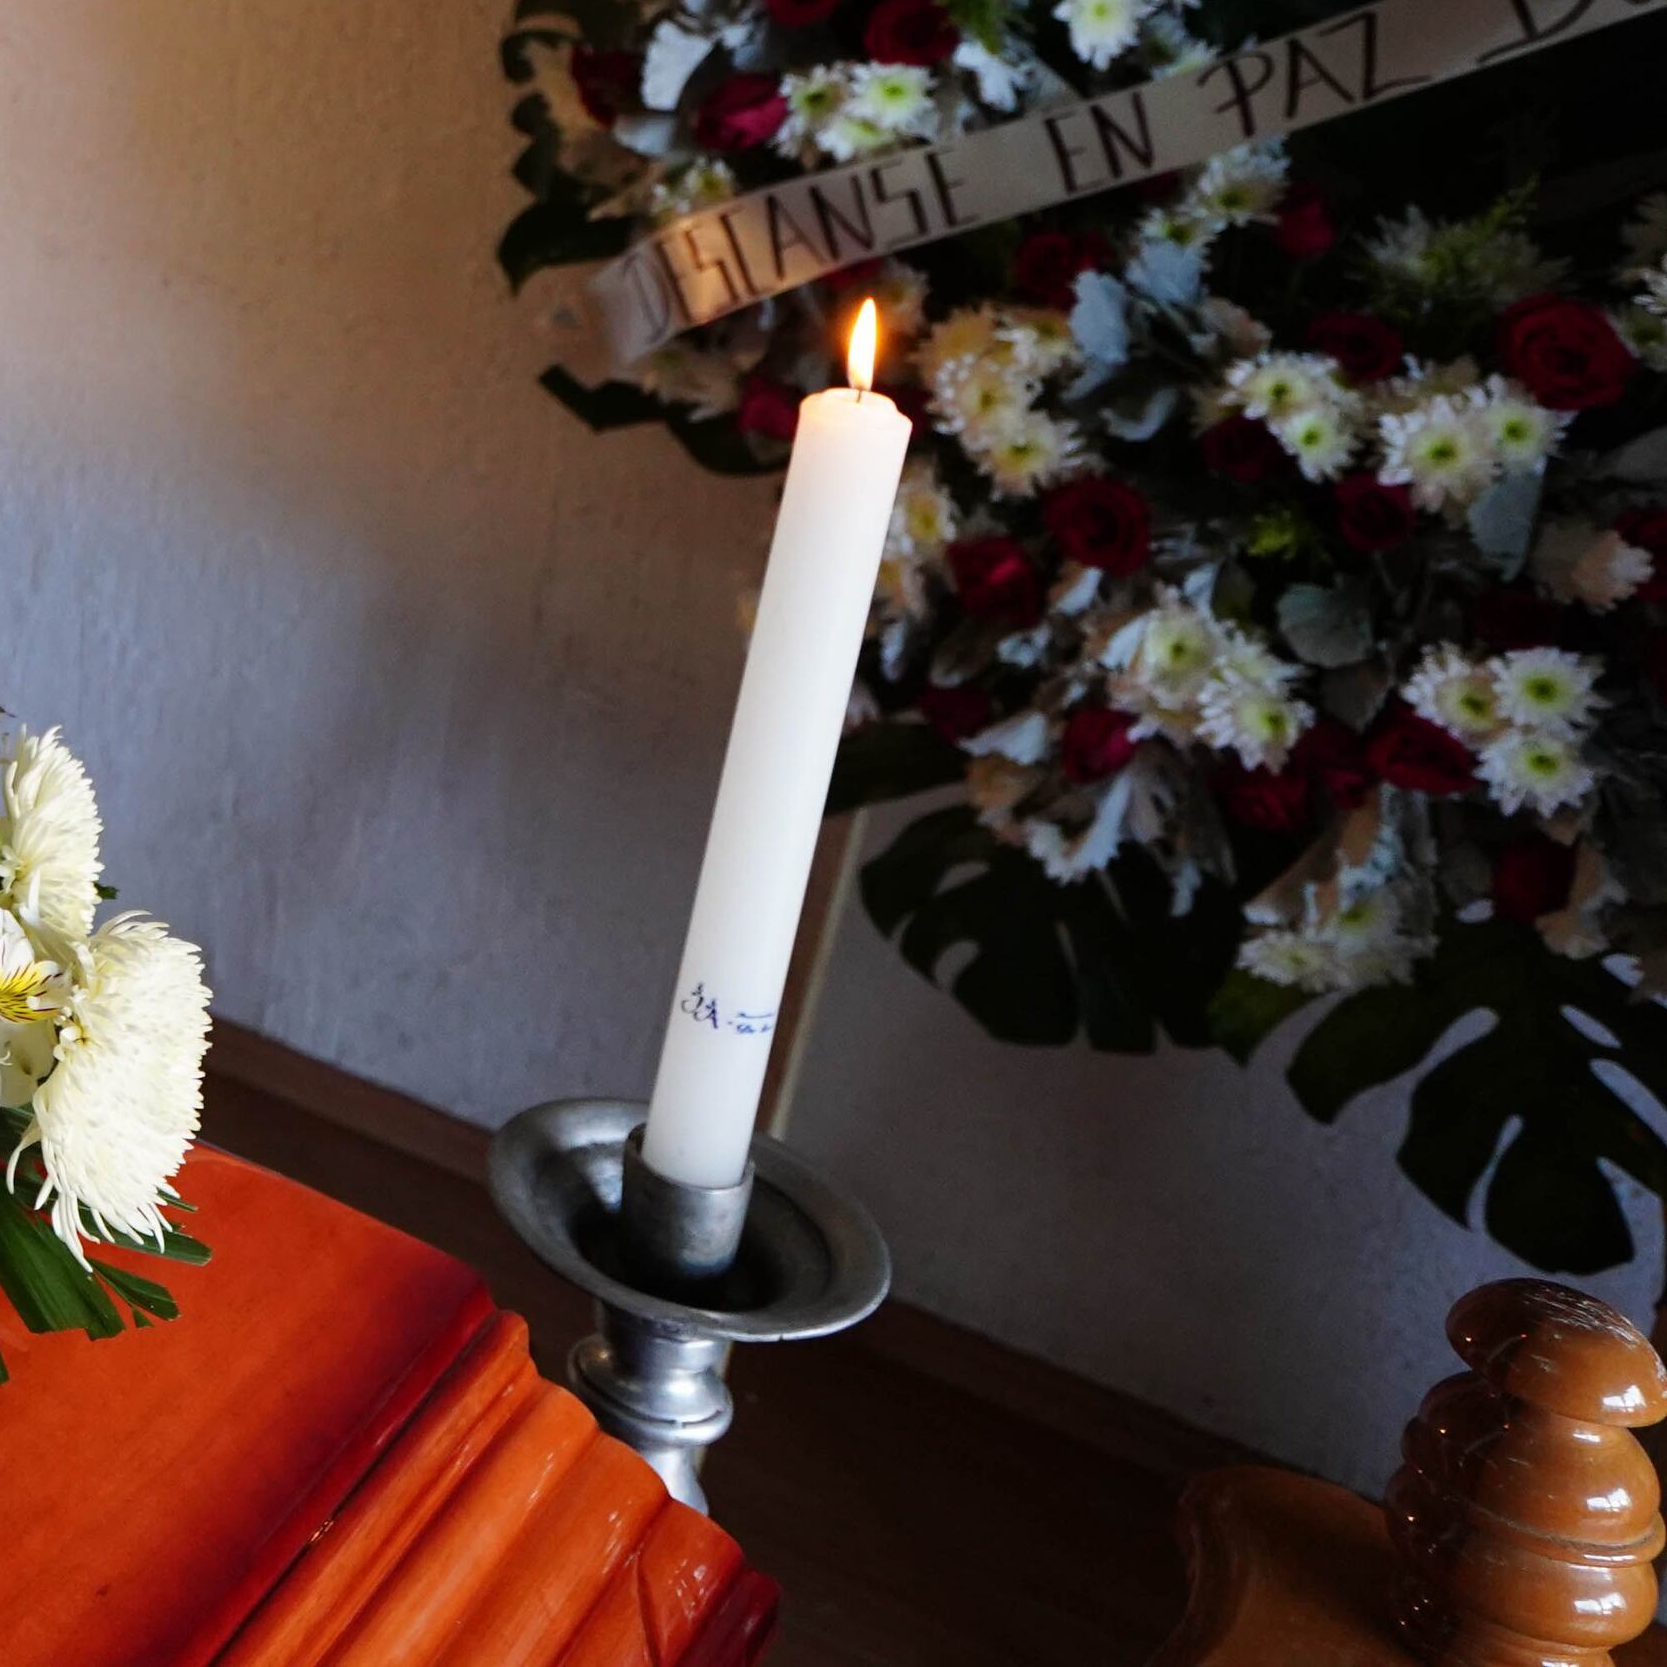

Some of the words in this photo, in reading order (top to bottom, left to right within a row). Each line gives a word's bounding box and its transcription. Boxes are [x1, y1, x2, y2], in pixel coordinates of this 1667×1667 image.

[621, 147, 981, 344] DESCANSE
[1043, 91, 1156, 193] EN
[1196, 10, 1433, 138] PAZ
